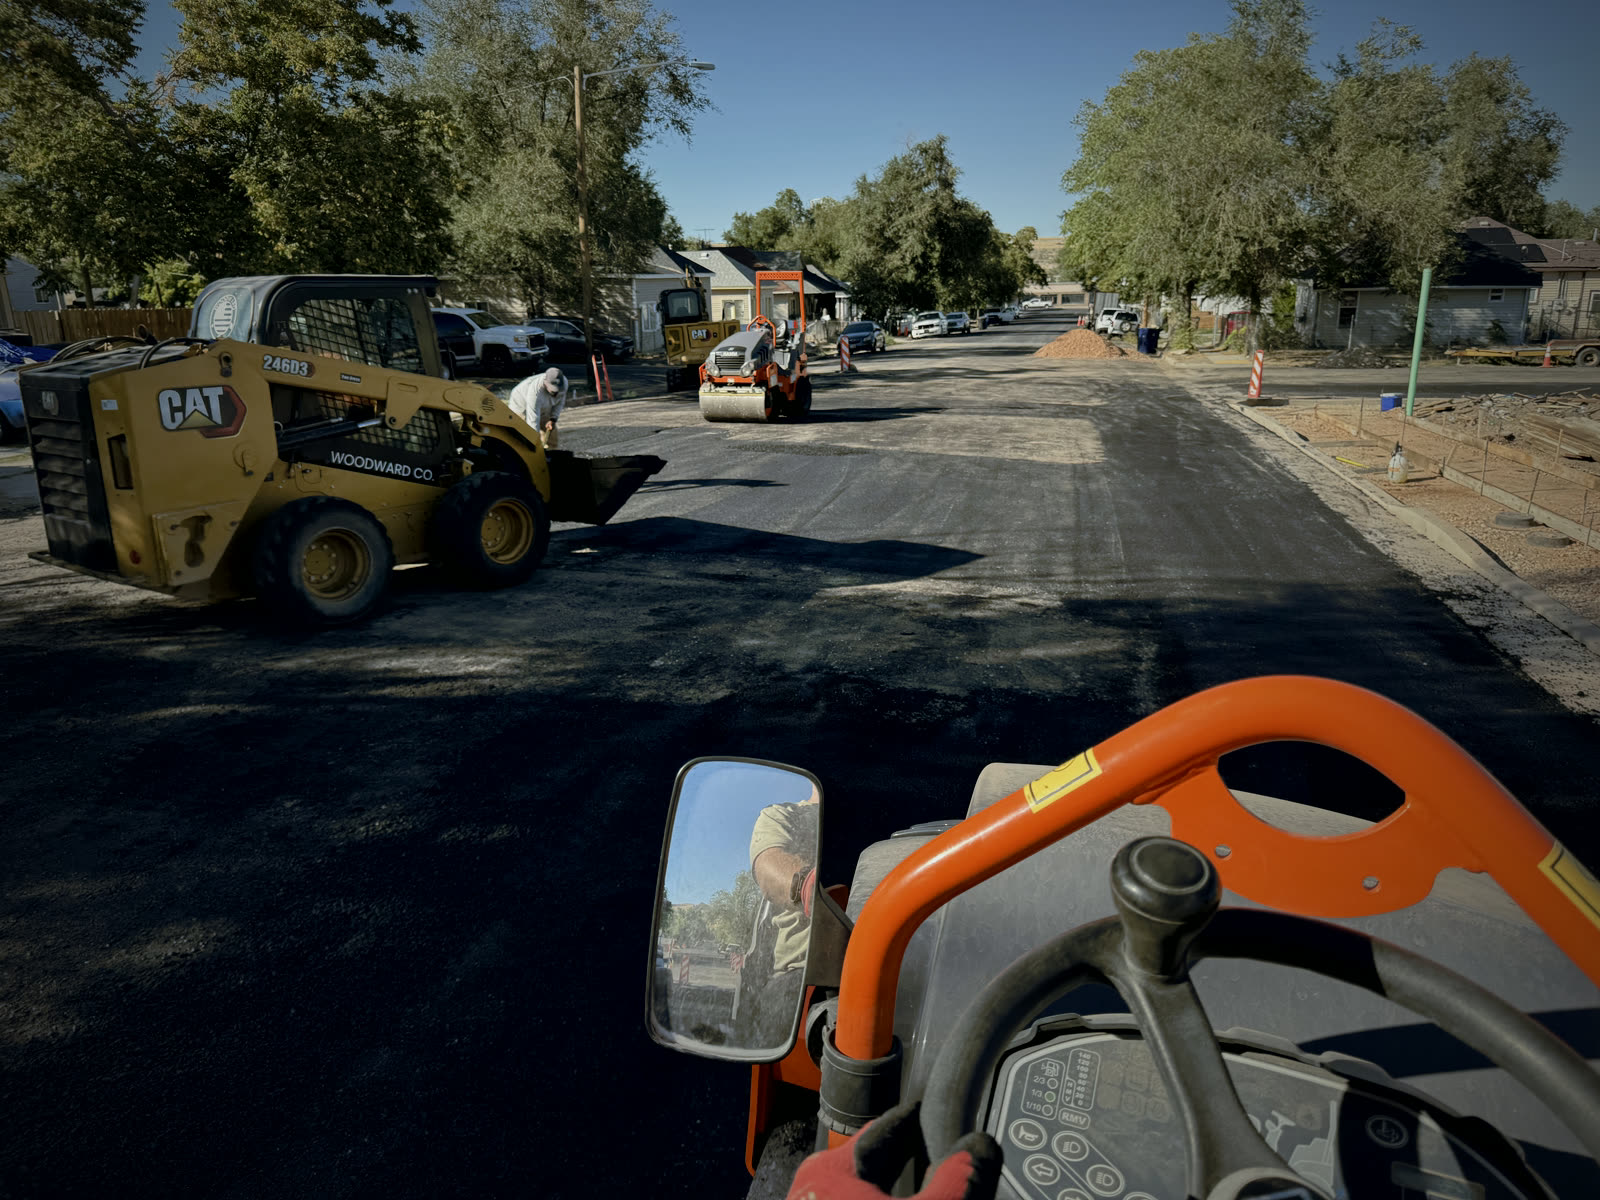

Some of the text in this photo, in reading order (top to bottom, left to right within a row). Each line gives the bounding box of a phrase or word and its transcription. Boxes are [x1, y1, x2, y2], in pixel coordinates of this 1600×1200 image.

[692, 329, 707, 340] CAT
[263, 354, 309, 377] 246D3
[158, 385, 224, 430] CAT
[330, 450, 435, 482] WOODWARD CO.
[1077, 1065, 1089, 1073] 100
[1033, 1075, 1046, 1084] 2/3
[1031, 1088, 1043, 1098] 1/3
[1026, 1101, 1042, 1112] 1/10
[1062, 1112, 1087, 1124] RMV
